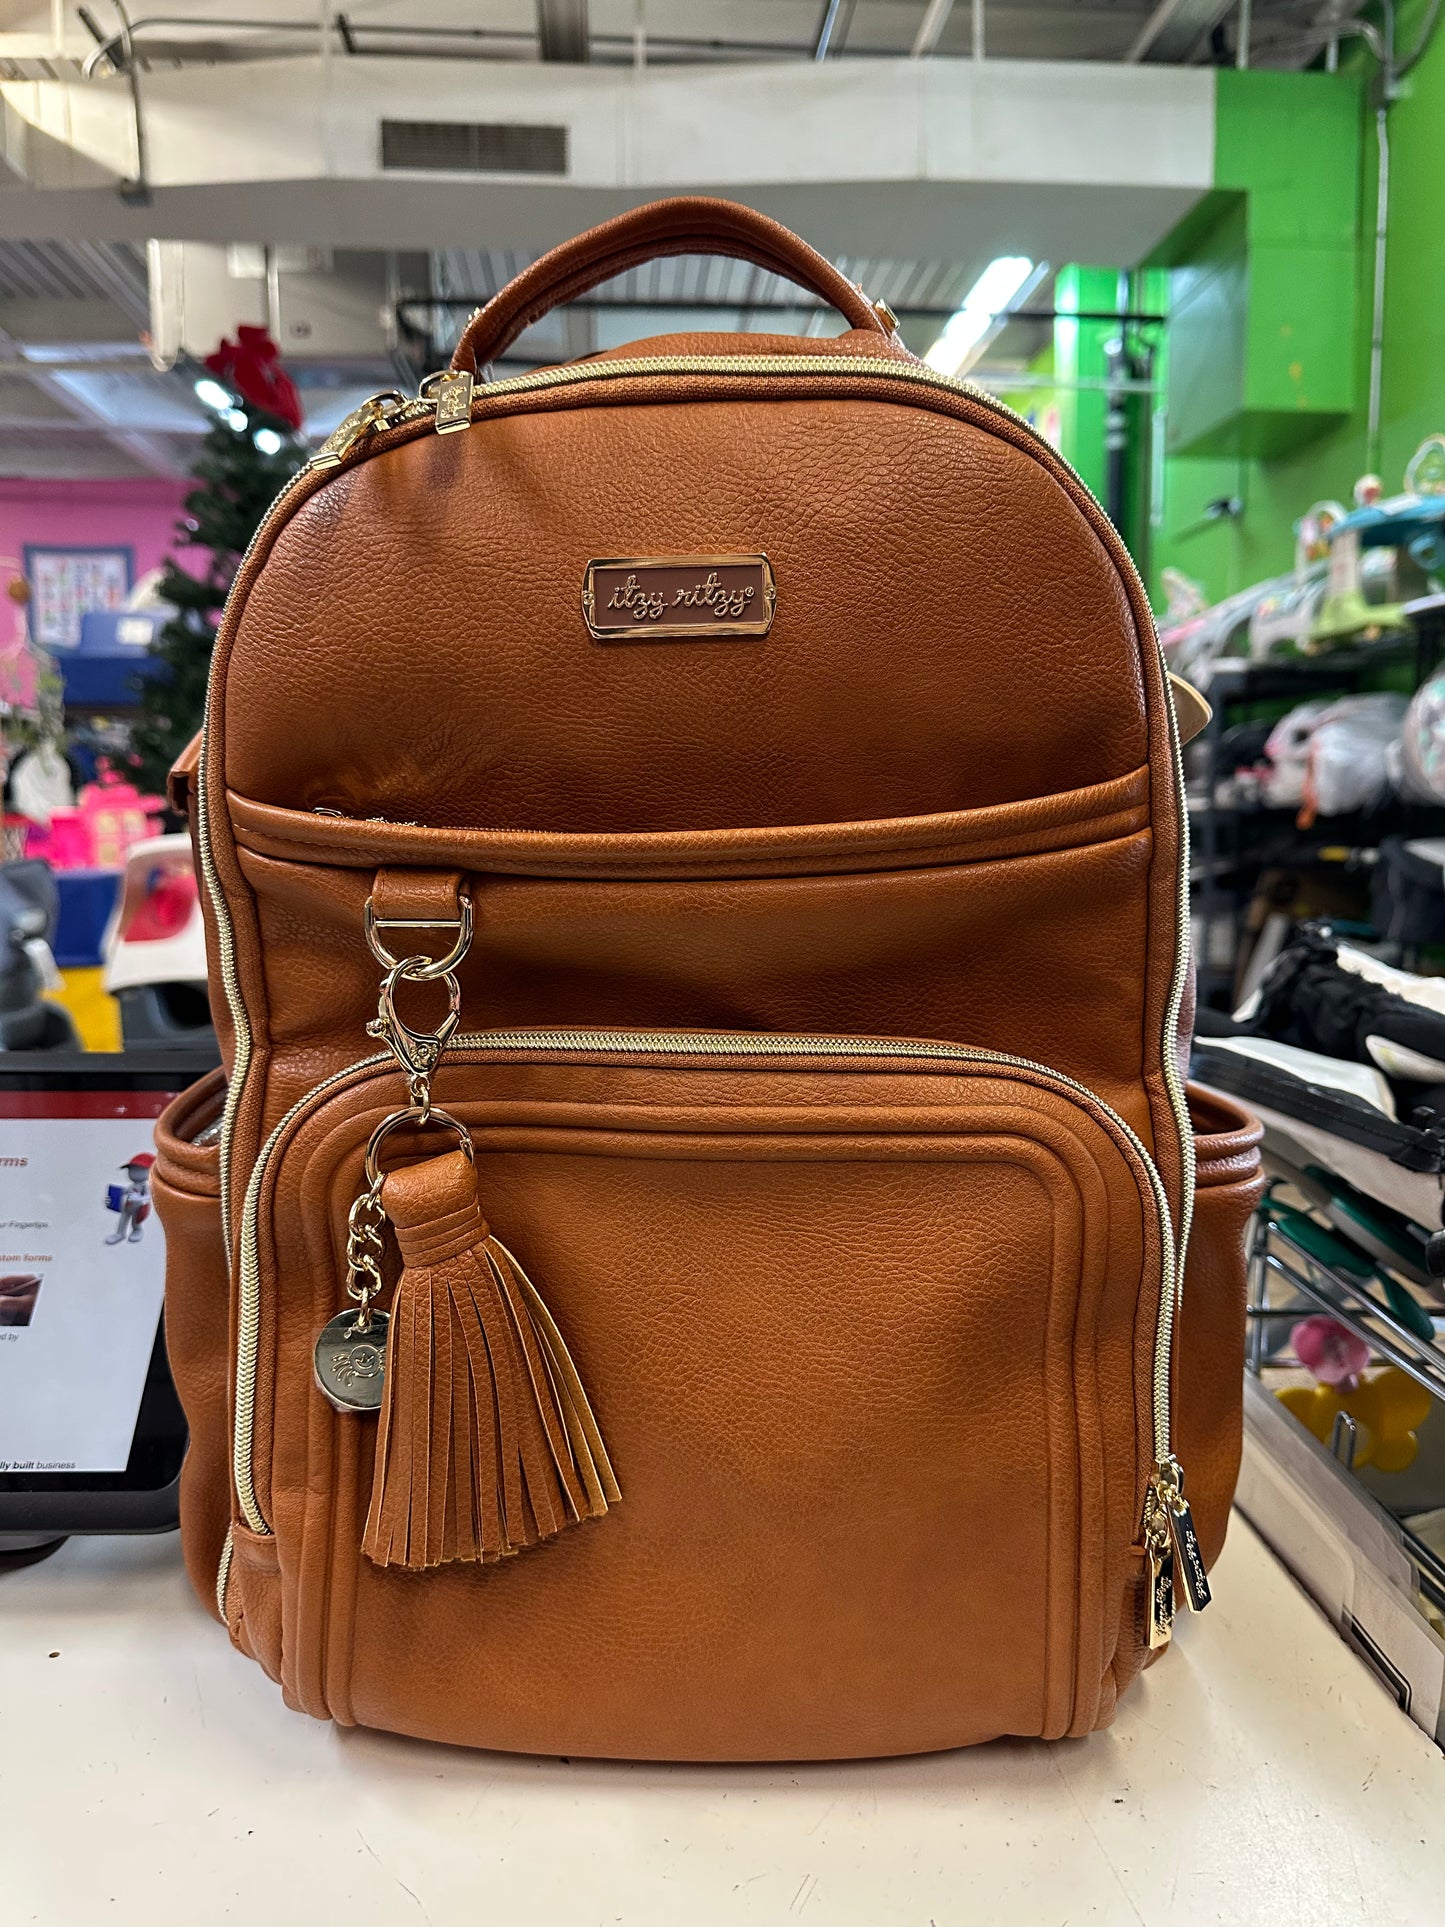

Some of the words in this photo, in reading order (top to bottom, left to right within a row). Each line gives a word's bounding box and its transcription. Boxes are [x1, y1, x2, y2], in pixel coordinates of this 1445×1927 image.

[607, 574, 669, 620] itzy
[23, 1253, 53, 1262] forms
[13, 1460, 35, 1470] built
[36, 1460, 76, 1470] business
